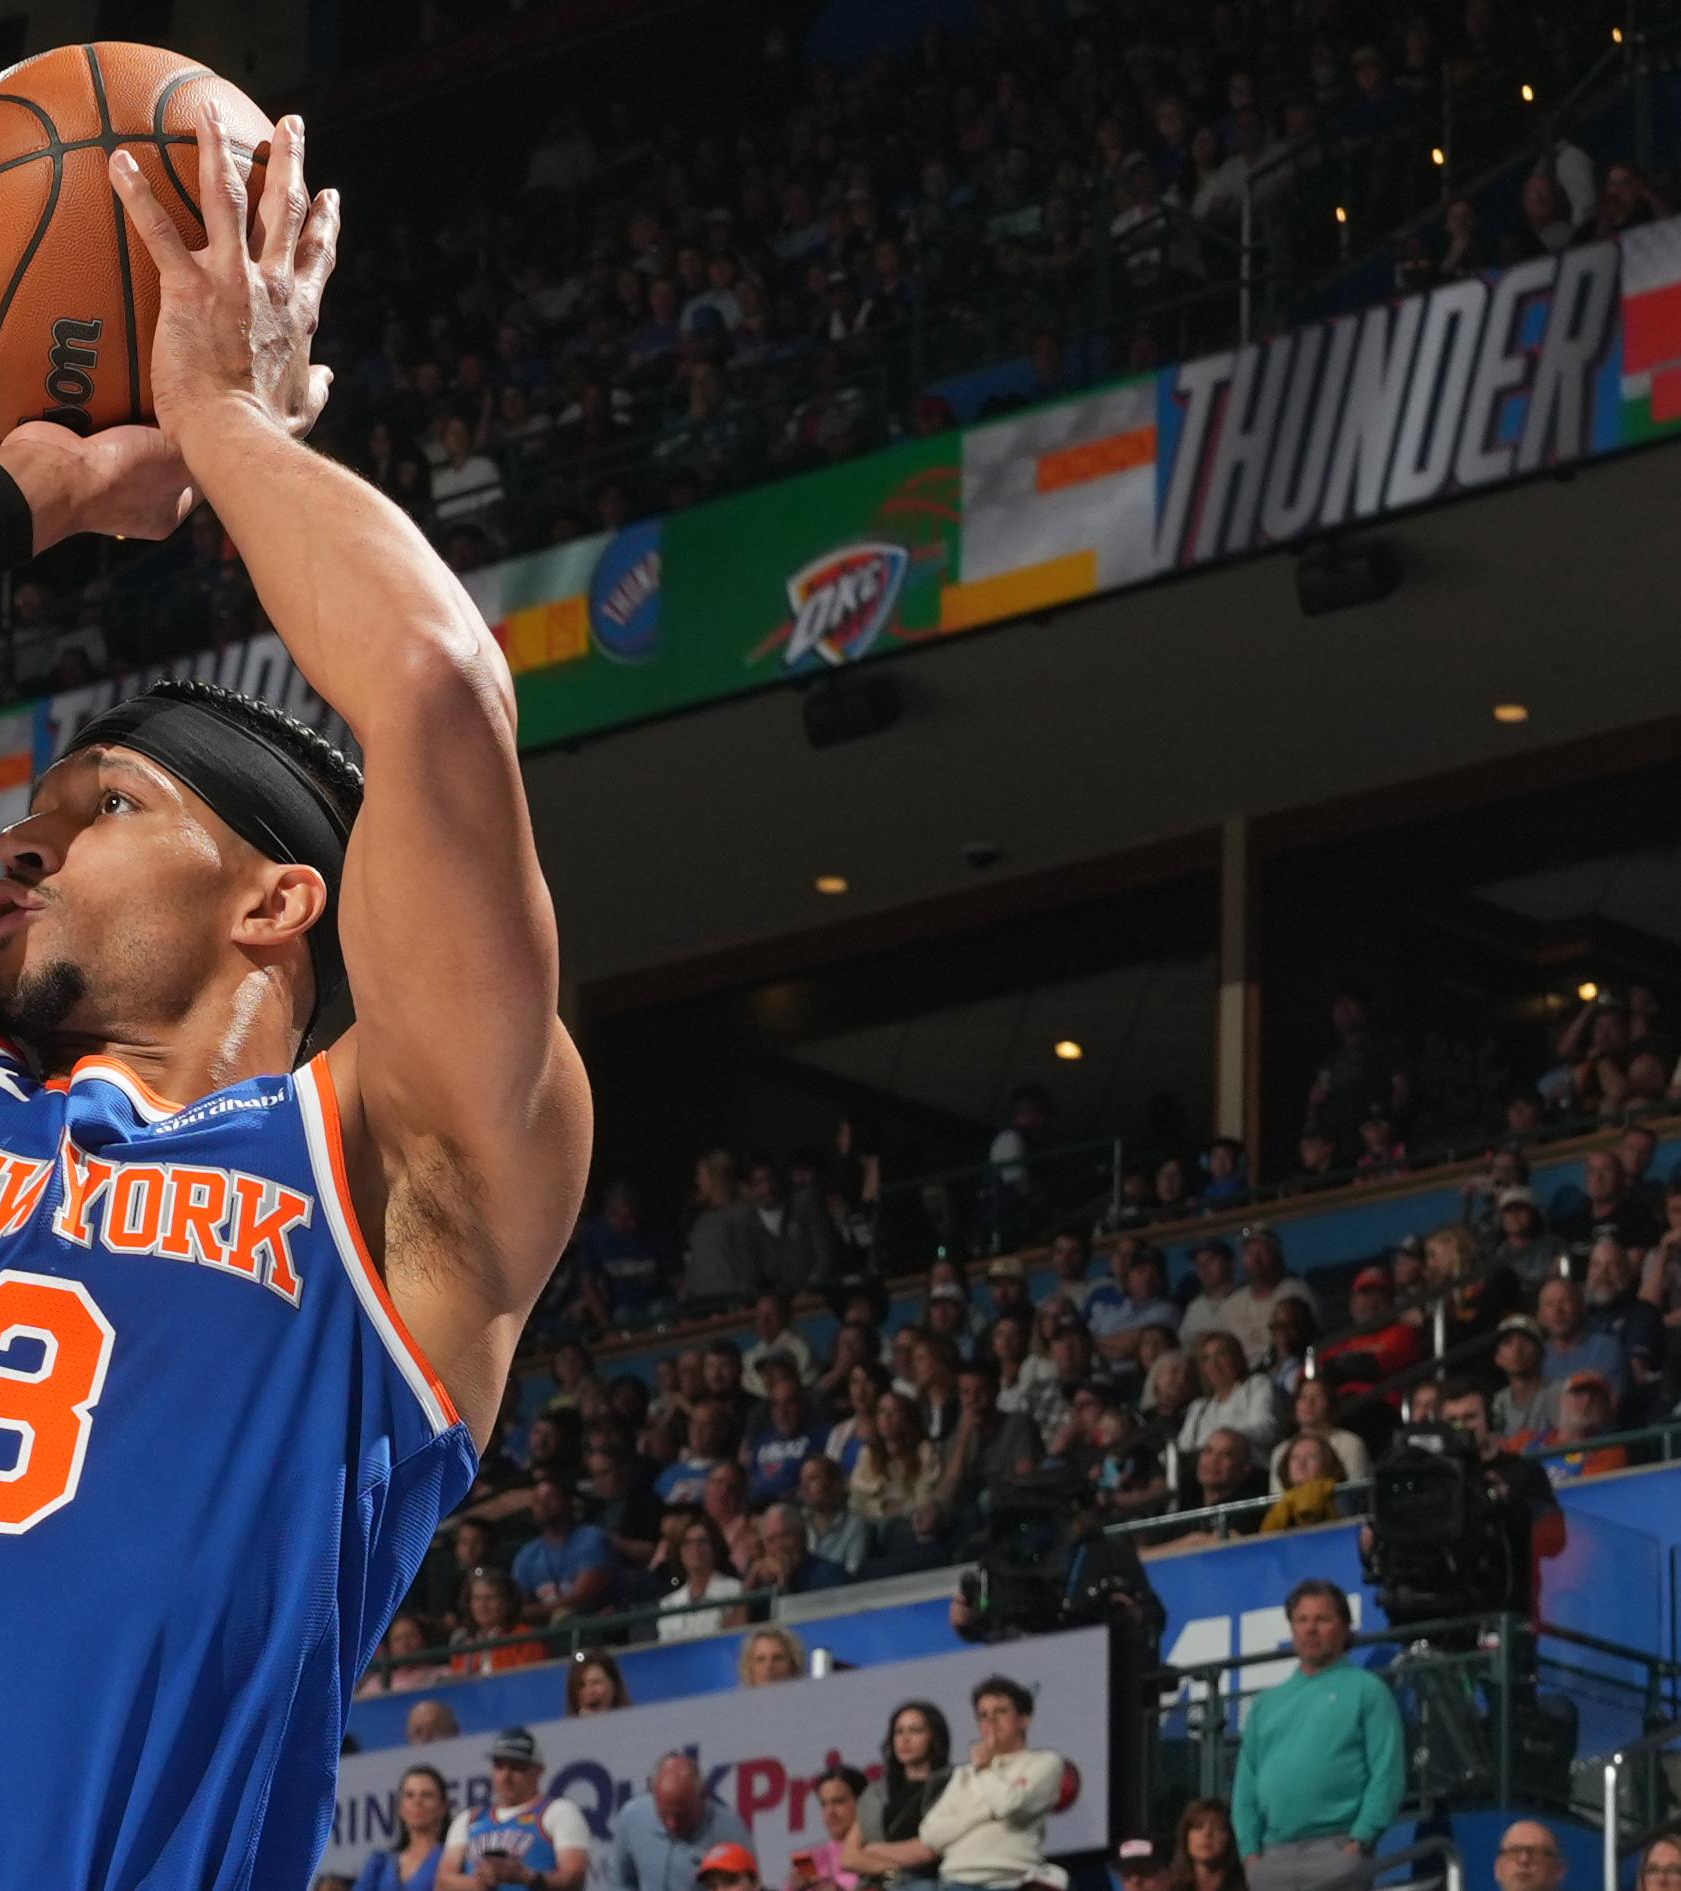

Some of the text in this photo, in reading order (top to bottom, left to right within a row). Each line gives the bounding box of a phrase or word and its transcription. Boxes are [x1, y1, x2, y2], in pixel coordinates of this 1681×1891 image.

[1151, 238, 1618, 578] THUNDER
[208, 1086, 285, 1117] dhabi
[51, 1125, 315, 1310] YORK
